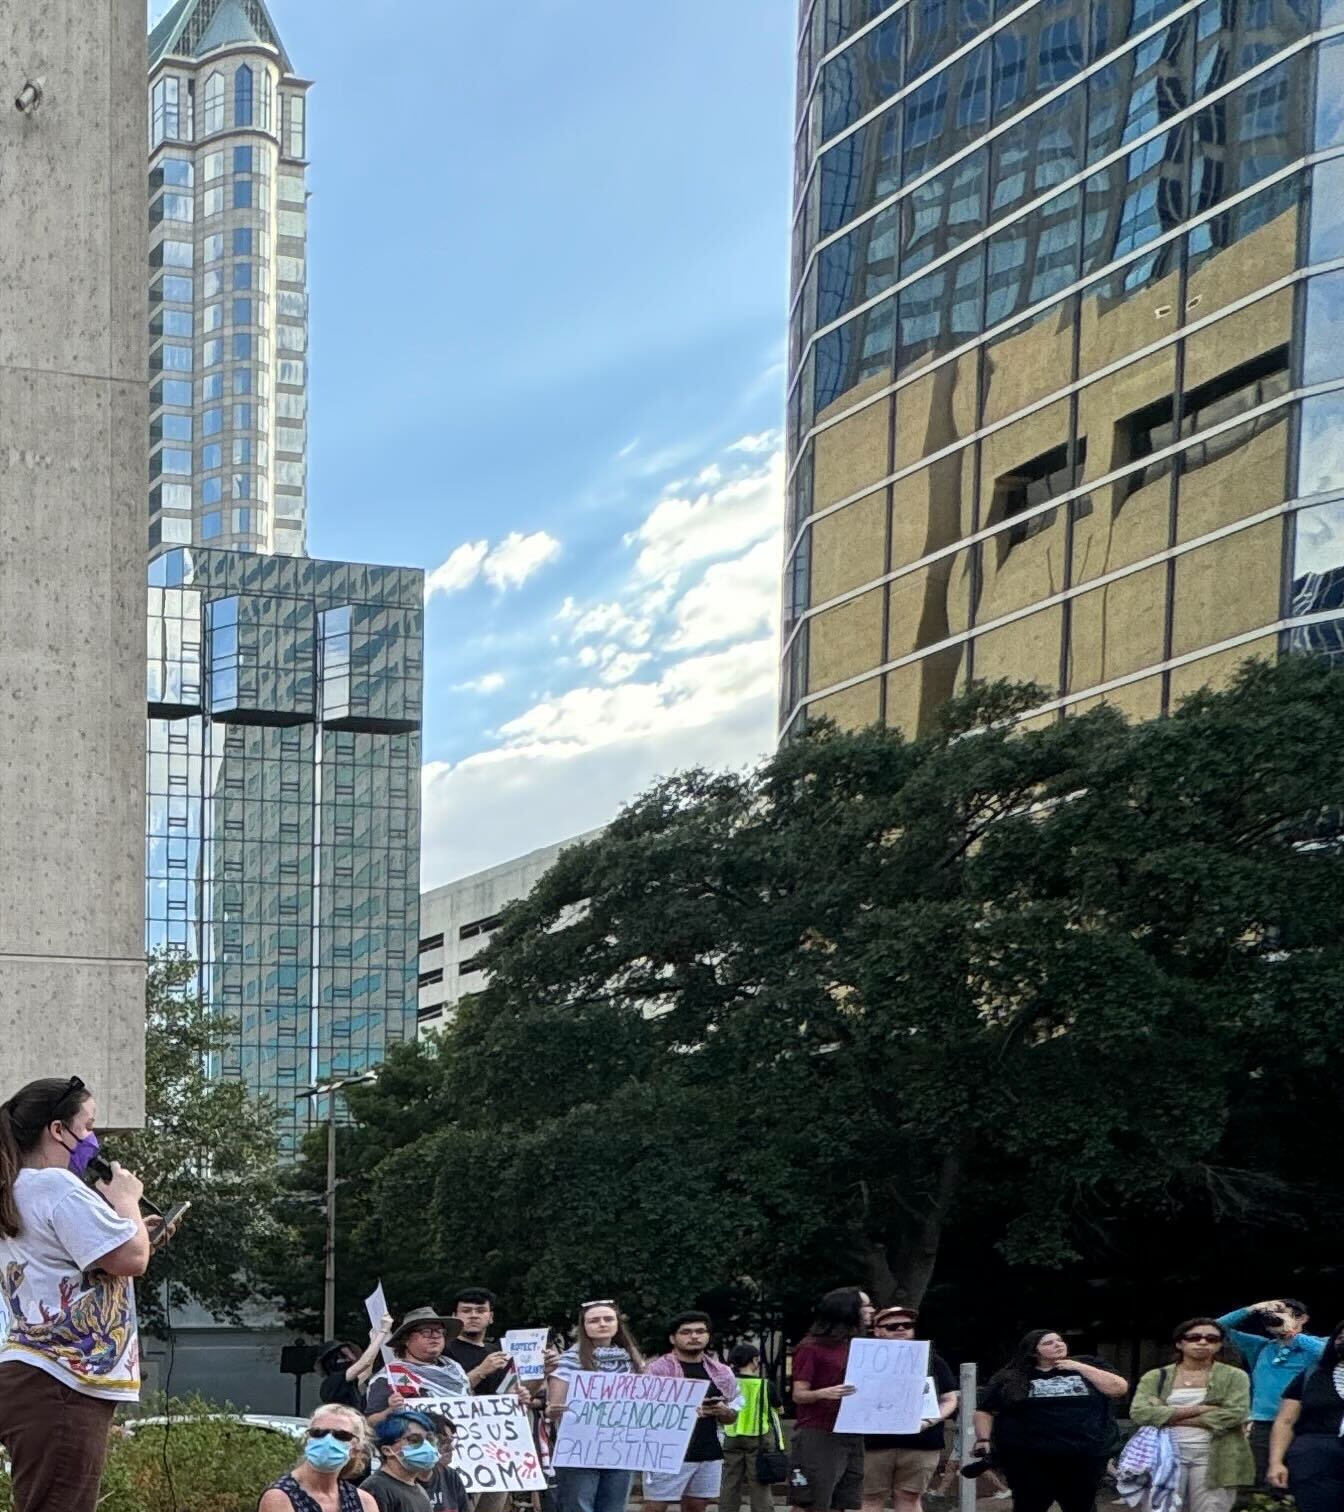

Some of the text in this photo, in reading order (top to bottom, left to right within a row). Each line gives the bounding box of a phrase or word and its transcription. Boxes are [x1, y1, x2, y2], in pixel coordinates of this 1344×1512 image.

[574, 1374, 706, 1403] NEW PRESIDENT
[567, 1400, 609, 1428] SAME
[487, 1419, 519, 1441] US
[595, 1426, 659, 1444] FREE
[553, 1437, 680, 1471] PALESTINE
